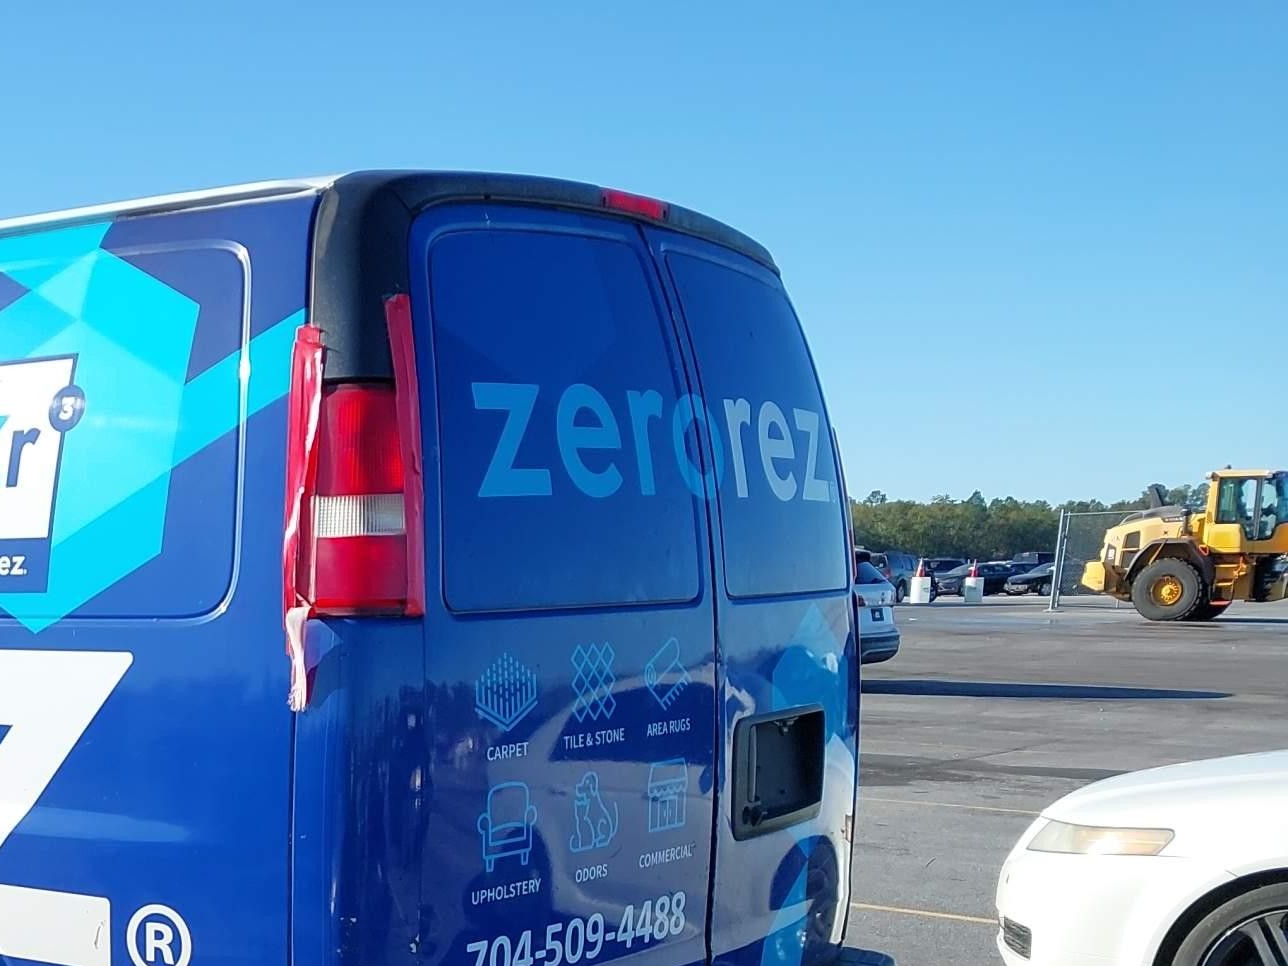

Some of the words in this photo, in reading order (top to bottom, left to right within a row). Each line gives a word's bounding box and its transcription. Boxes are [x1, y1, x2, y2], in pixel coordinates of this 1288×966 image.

[472, 383, 831, 502] zerorez
[647, 721, 669, 737] AREA
[669, 718, 691, 734] RUGS
[564, 735, 585, 750] TILE
[586, 733, 594, 747] &
[595, 728, 625, 746] STONE
[487, 742, 530, 761] CARPET
[639, 843, 693, 868] COMMERCIAL
[575, 864, 608, 883] ODORS
[471, 878, 542, 905] UPHOLSTERY
